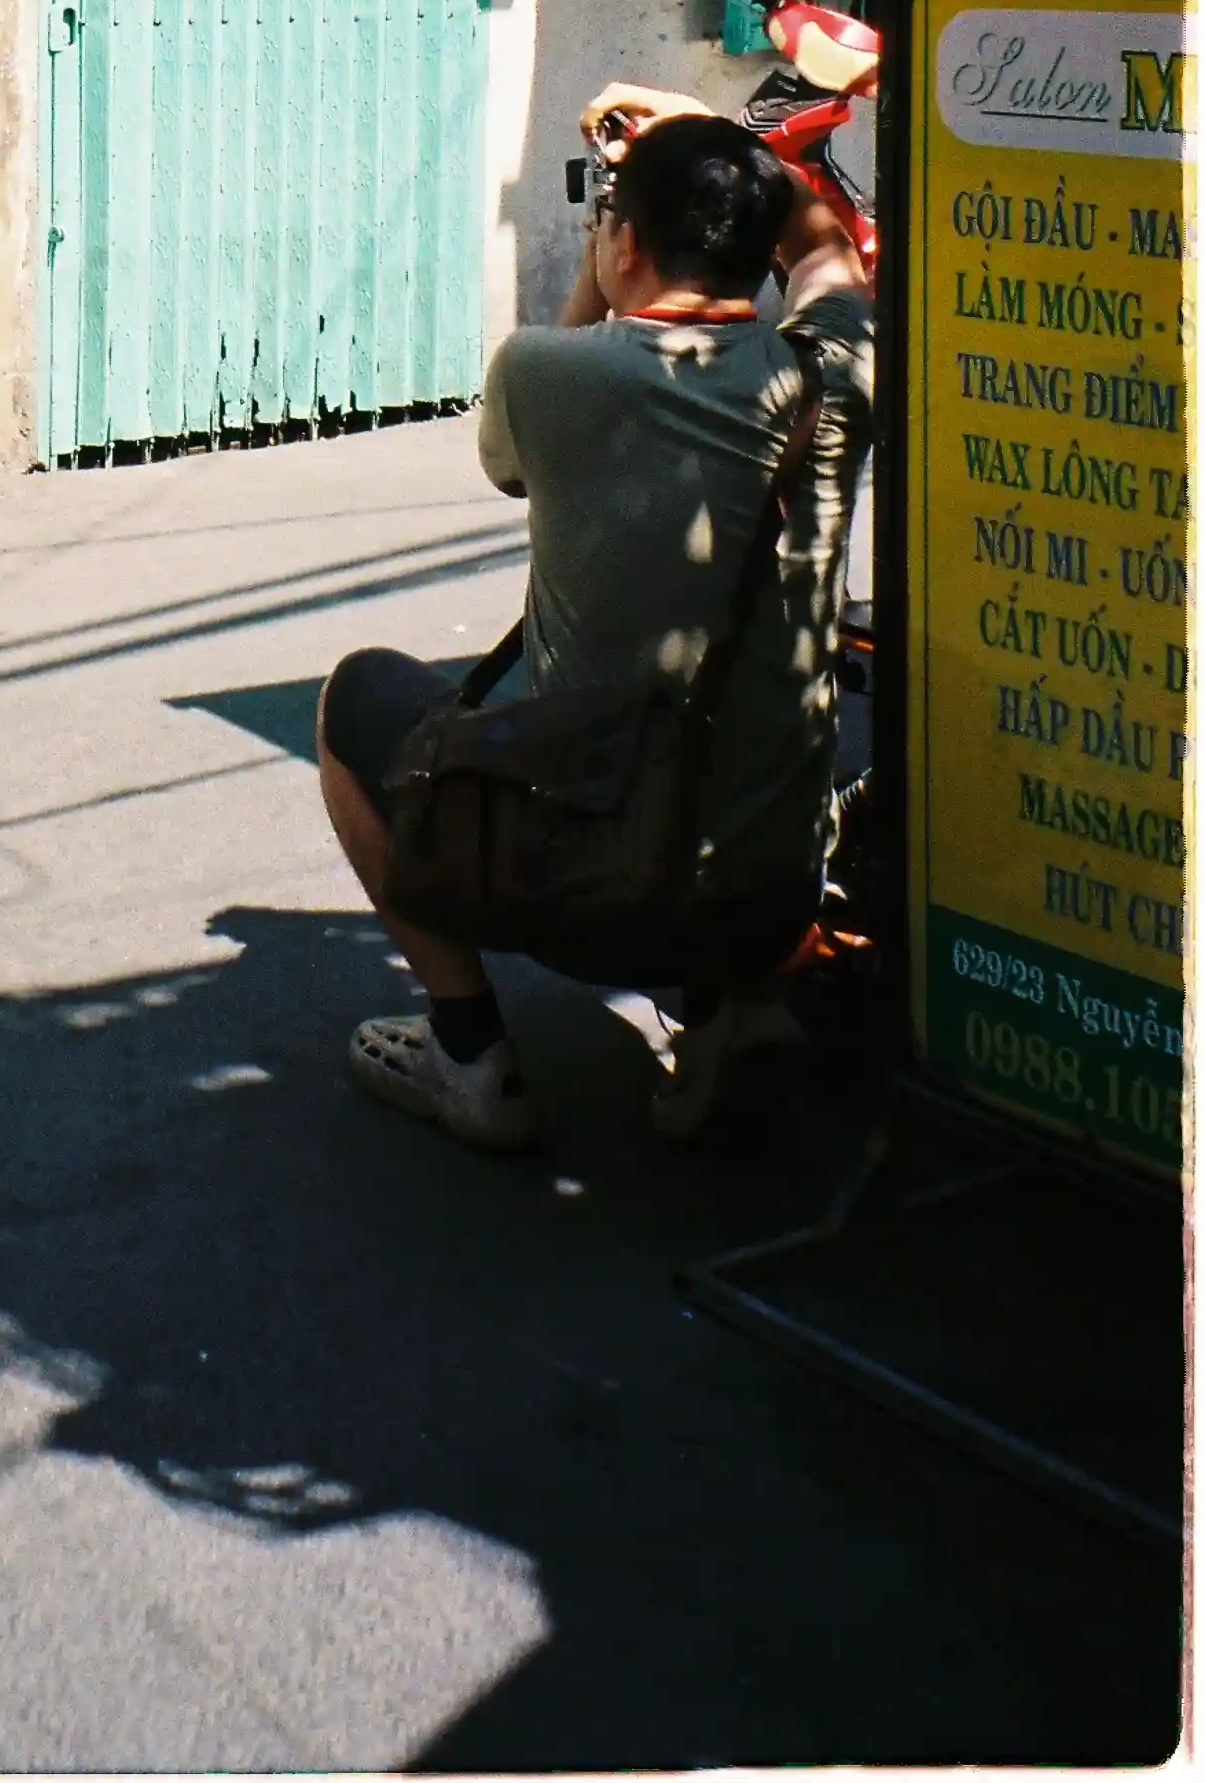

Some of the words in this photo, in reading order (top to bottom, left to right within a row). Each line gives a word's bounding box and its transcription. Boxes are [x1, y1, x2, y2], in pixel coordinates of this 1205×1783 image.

[953, 32, 1112, 112] Salon
[953, 179, 1013, 252] GỘI
[1023, 174, 1099, 251] ĐẦU
[956, 260, 1027, 325] LÀM
[1036, 272, 1143, 341] MÓNG
[958, 352, 1072, 414] TRANG
[1084, 352, 1179, 433] ĐIỂM
[962, 434, 1031, 491] WAX
[1040, 439, 1140, 510] LÔNG
[974, 502, 1036, 574] NỐI
[1045, 530, 1088, 587] MI
[980, 581, 1047, 659] CẮT
[1055, 604, 1134, 681] UỐN
[998, 673, 1070, 746] HẤP
[1081, 688, 1156, 772] DẦU
[1017, 772, 1184, 868] MASSAGE
[1044, 861, 1117, 933] HÚT
[952, 937, 1045, 1006] 629/23
[1055, 972, 1183, 1057] Nguyễn
